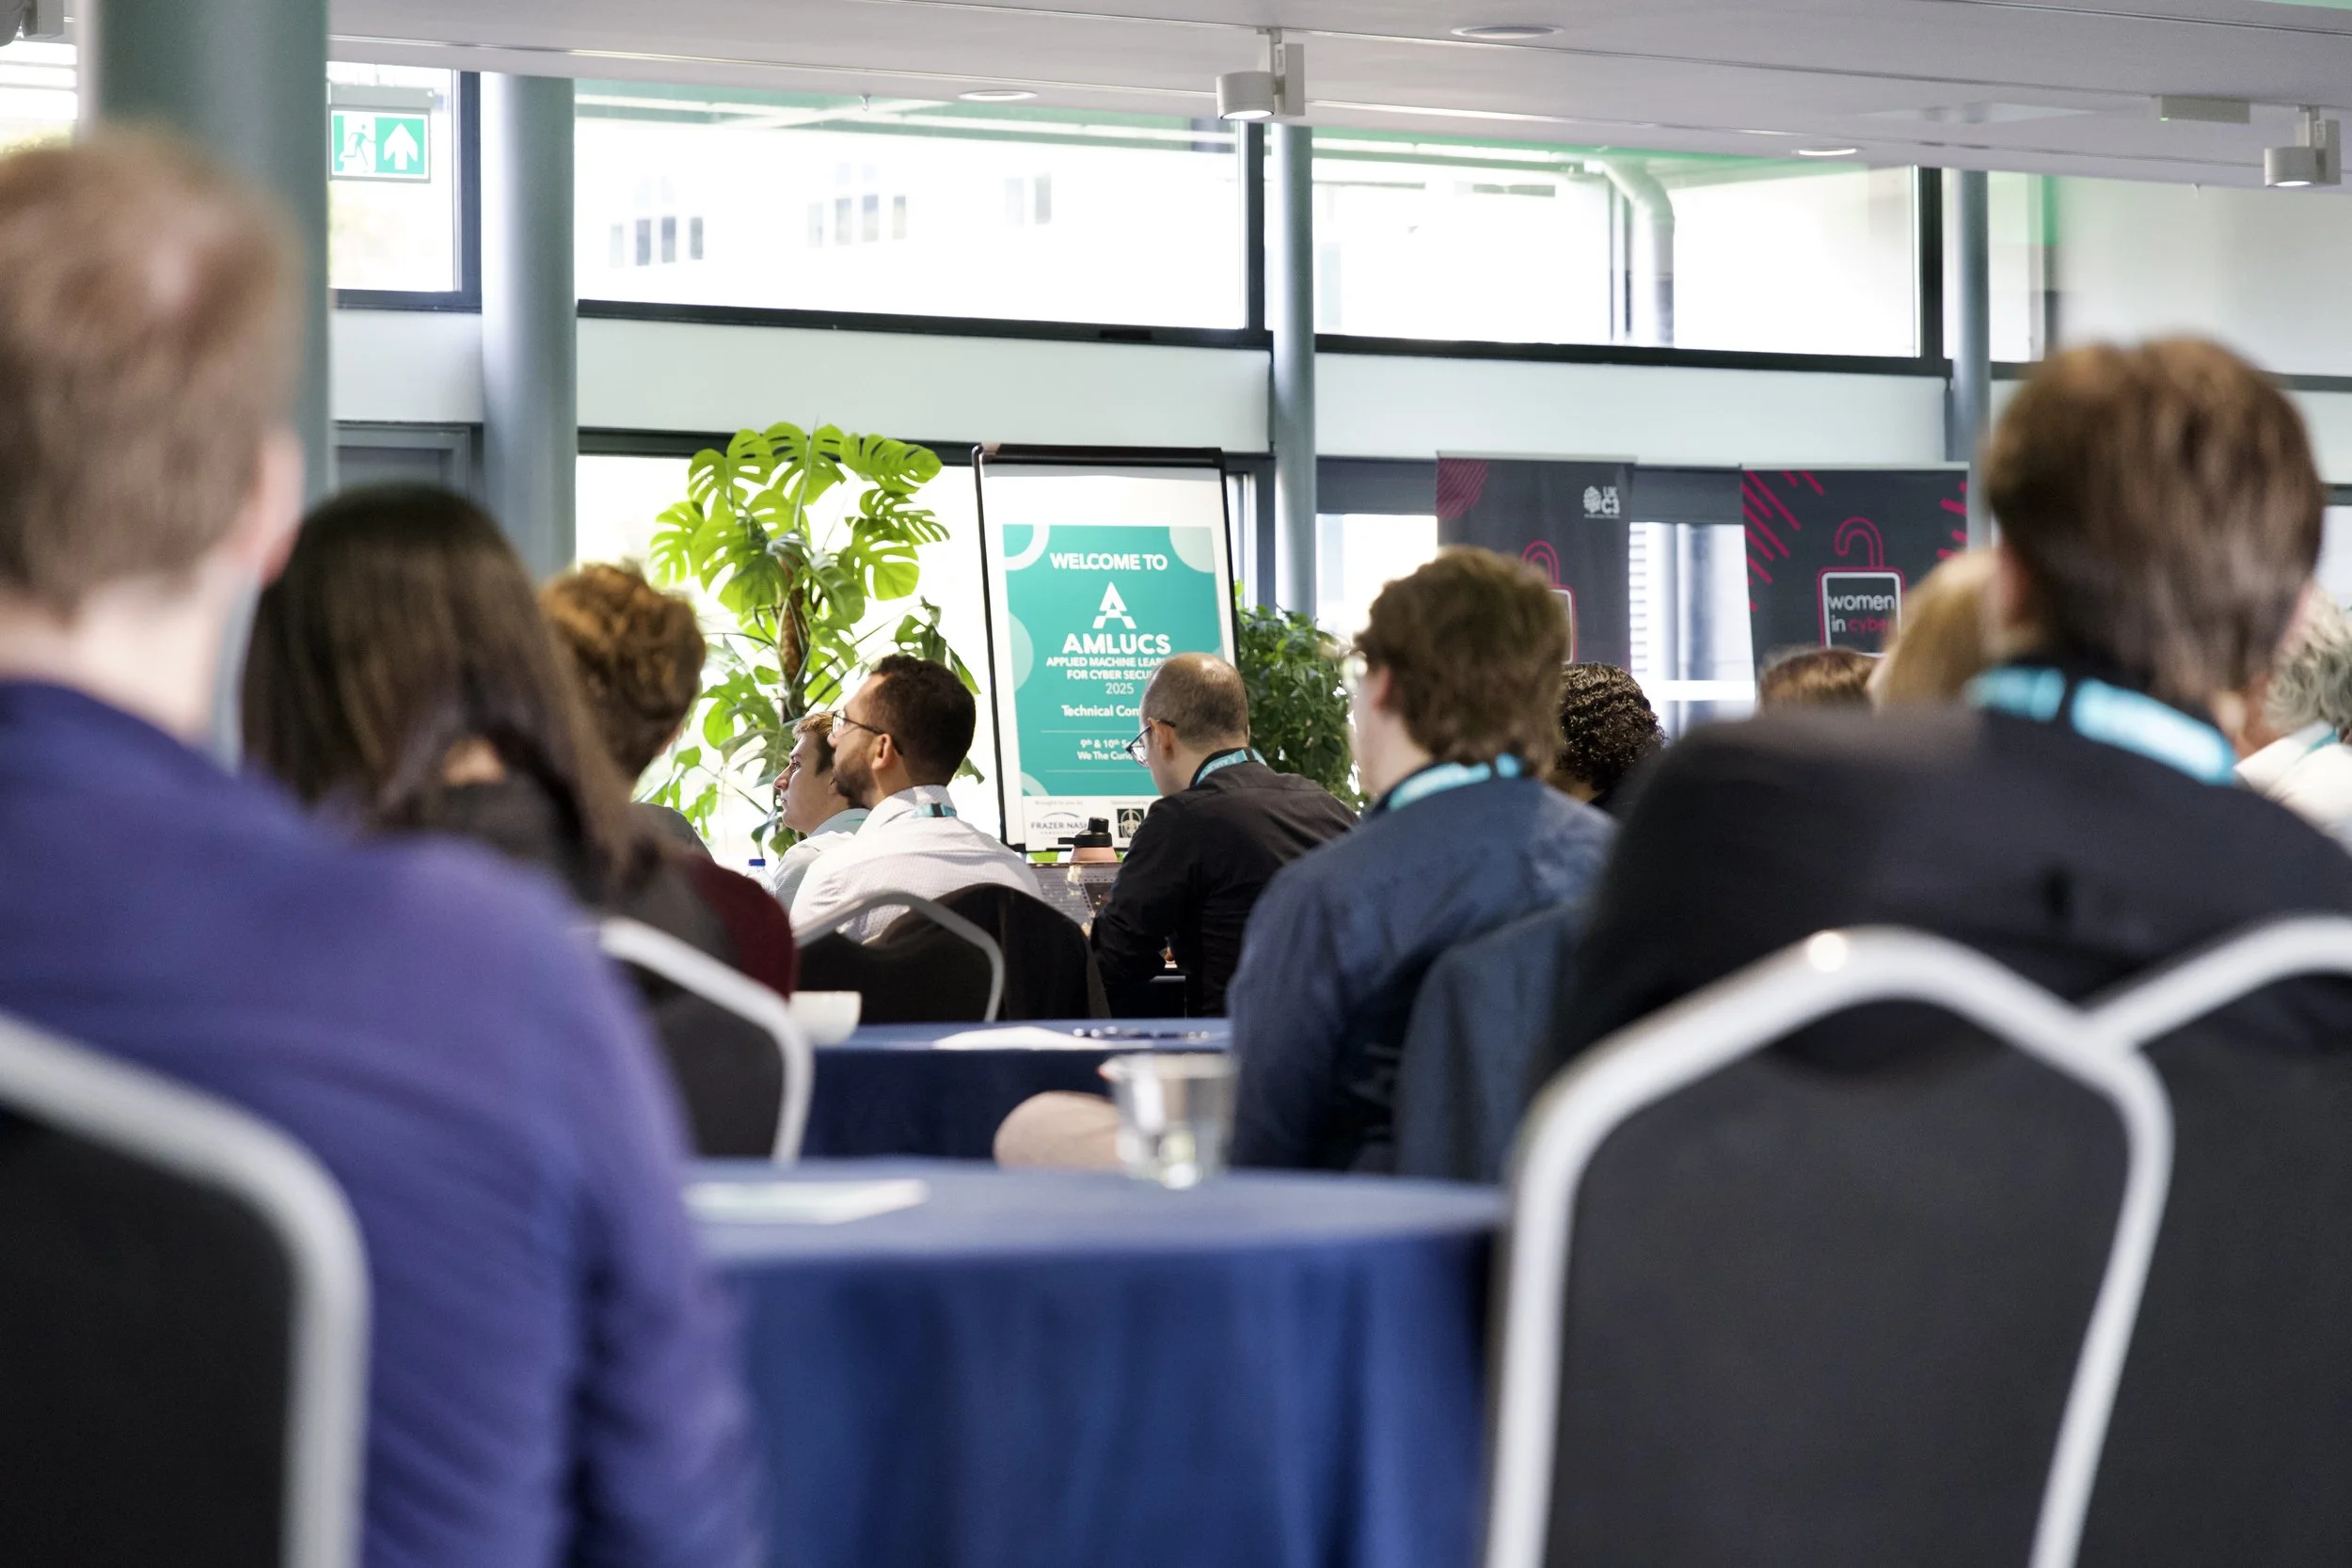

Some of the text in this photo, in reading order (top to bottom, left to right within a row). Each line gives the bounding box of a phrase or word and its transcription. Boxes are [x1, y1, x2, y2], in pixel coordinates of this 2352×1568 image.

[1049, 552, 1168, 571] WELCOME TO
[1828, 594, 1895, 611] women
[1831, 614, 1888, 633] in cybe
[1062, 633, 1171, 655] AMLUCS
[1046, 657, 1088, 667] APPLIED
[1089, 657, 1136, 667] MACHINE
[1067, 670, 1089, 679] FOR
[1089, 670, 1121, 680] CYBER
[1104, 682, 1135, 695] 2025
[1060, 705, 1114, 717] Technical
[1093, 739, 1102, 749] &
[1076, 751, 1092, 760] We
[1092, 751, 1109, 760] The
